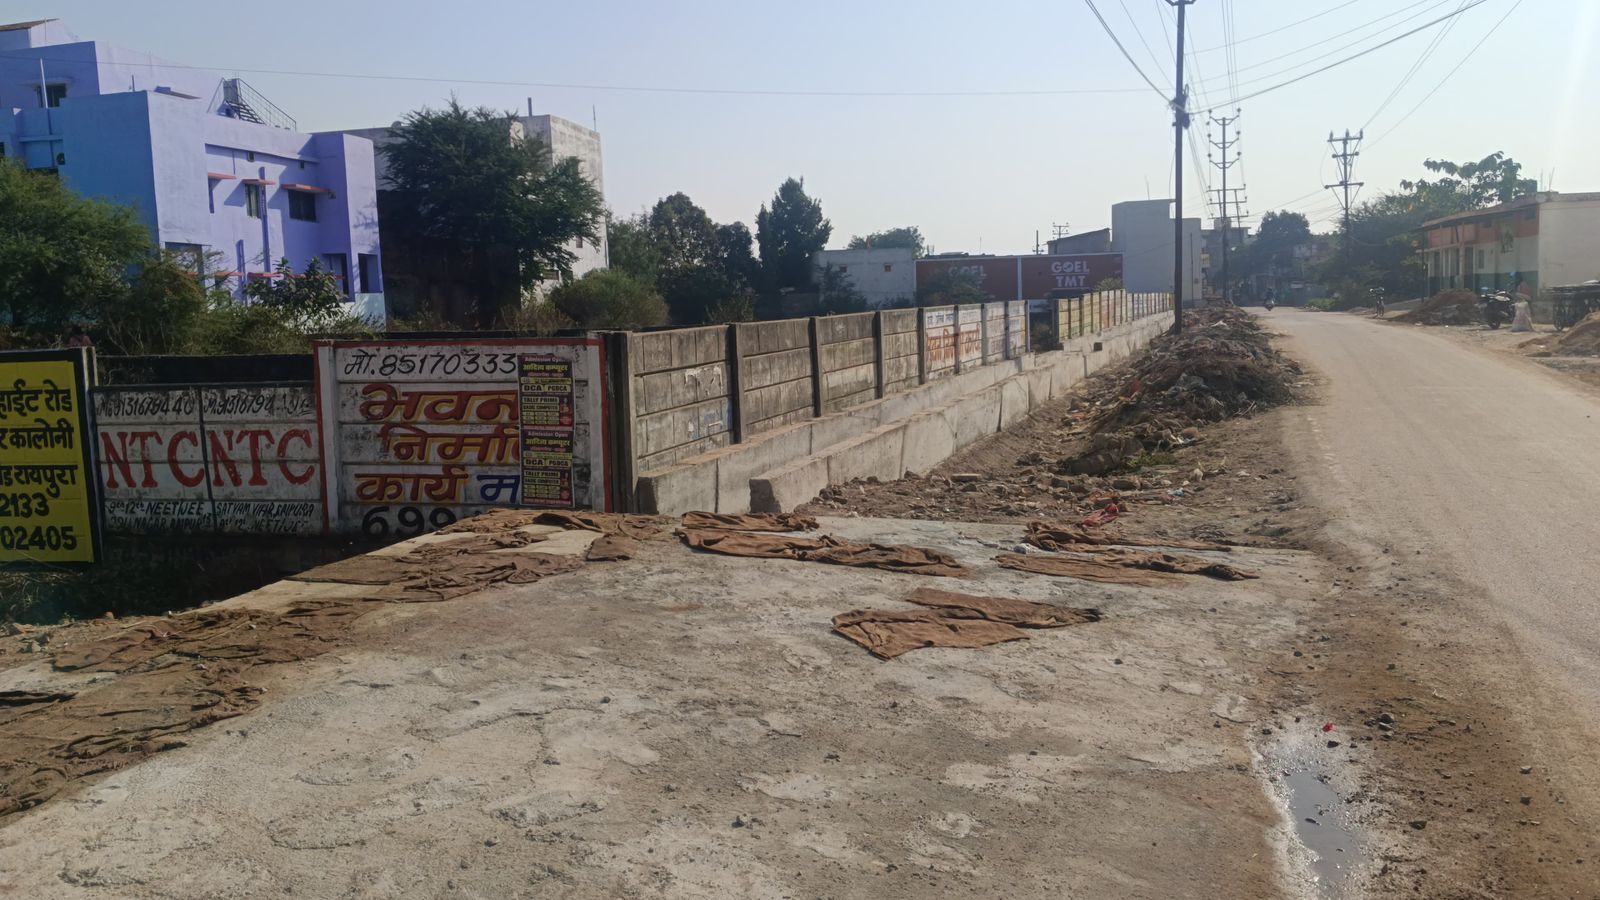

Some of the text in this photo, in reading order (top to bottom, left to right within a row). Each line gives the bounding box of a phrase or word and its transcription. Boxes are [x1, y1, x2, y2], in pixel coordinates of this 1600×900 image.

[1051, 261, 1090, 274] GOEL
[1056, 275, 1086, 287] TMT
[43, 379, 73, 412] रोड
[359, 384, 519, 422] भवन
[9, 418, 75, 450] कालोनी
[101, 430, 204, 488] NTC
[206, 427, 315, 488] NTC
[13, 464, 78, 498] रायपुरा
[355, 465, 469, 503] कार्य
[0, 525, 77, 552] 02405
